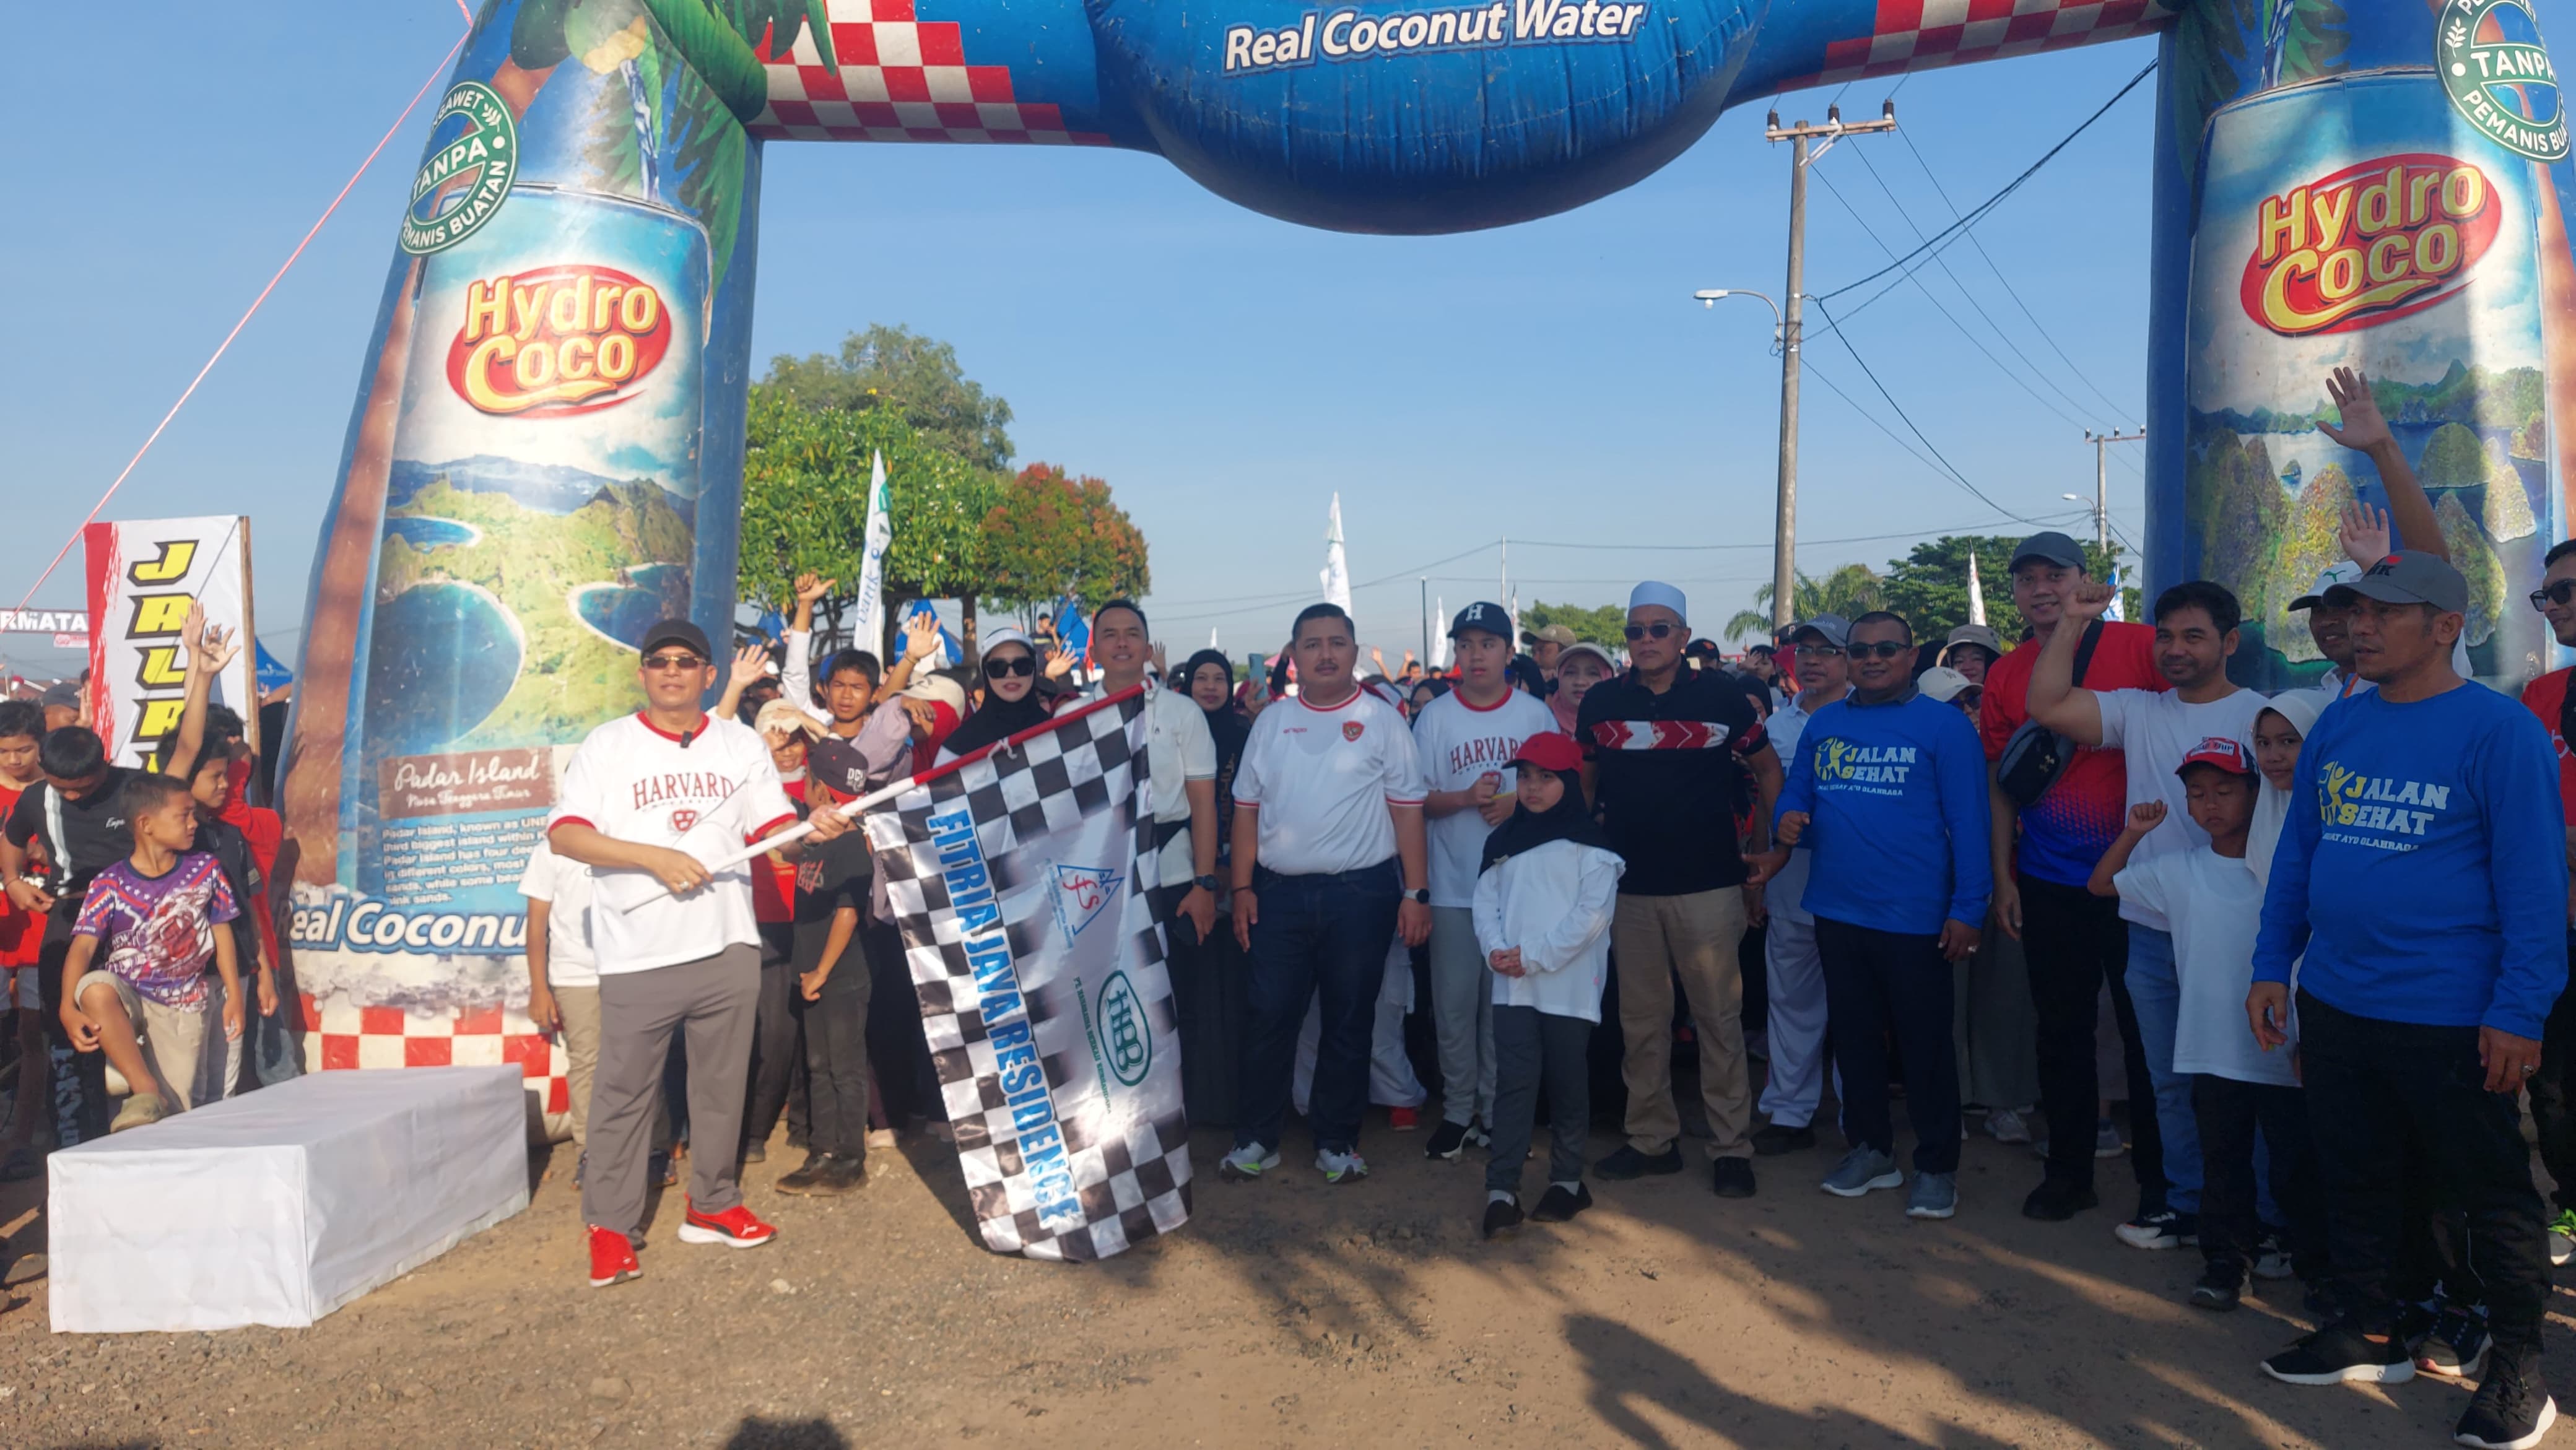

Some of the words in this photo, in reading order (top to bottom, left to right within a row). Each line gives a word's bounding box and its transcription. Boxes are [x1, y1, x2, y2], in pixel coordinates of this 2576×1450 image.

[1225, 15, 1315, 70] Real
[1322, 4, 1507, 55] Coconut
[1512, 0, 1643, 39] Water
[2471, 50, 2557, 82] TANPA
[2463, 90, 2548, 152] PEMANIS
[413, 137, 488, 199] TANPA
[449, 160, 507, 235] BUATAN
[2259, 165, 2487, 263] Hydro
[465, 275, 661, 342] Hydro
[2263, 224, 2463, 332] Coco
[464, 333, 637, 410] Coco
[394, 762, 463, 792] Padar
[468, 755, 541, 785] Island
[1450, 736, 1521, 774] HARVAR
[1841, 766, 1909, 783] SEHAT
[1845, 747, 1917, 763] JALAN
[633, 772, 735, 810] HARVARD
[2338, 803, 2435, 835] SEHAT
[2345, 776, 2450, 810] JALAN
[459, 821, 500, 833] known
[521, 817, 548, 828] UNE
[928, 809, 998, 932] FITRIA
[347, 901, 526, 947] Coconu
[966, 933, 1021, 1023] JAVA
[990, 1020, 1082, 1228] RESIDENCE
